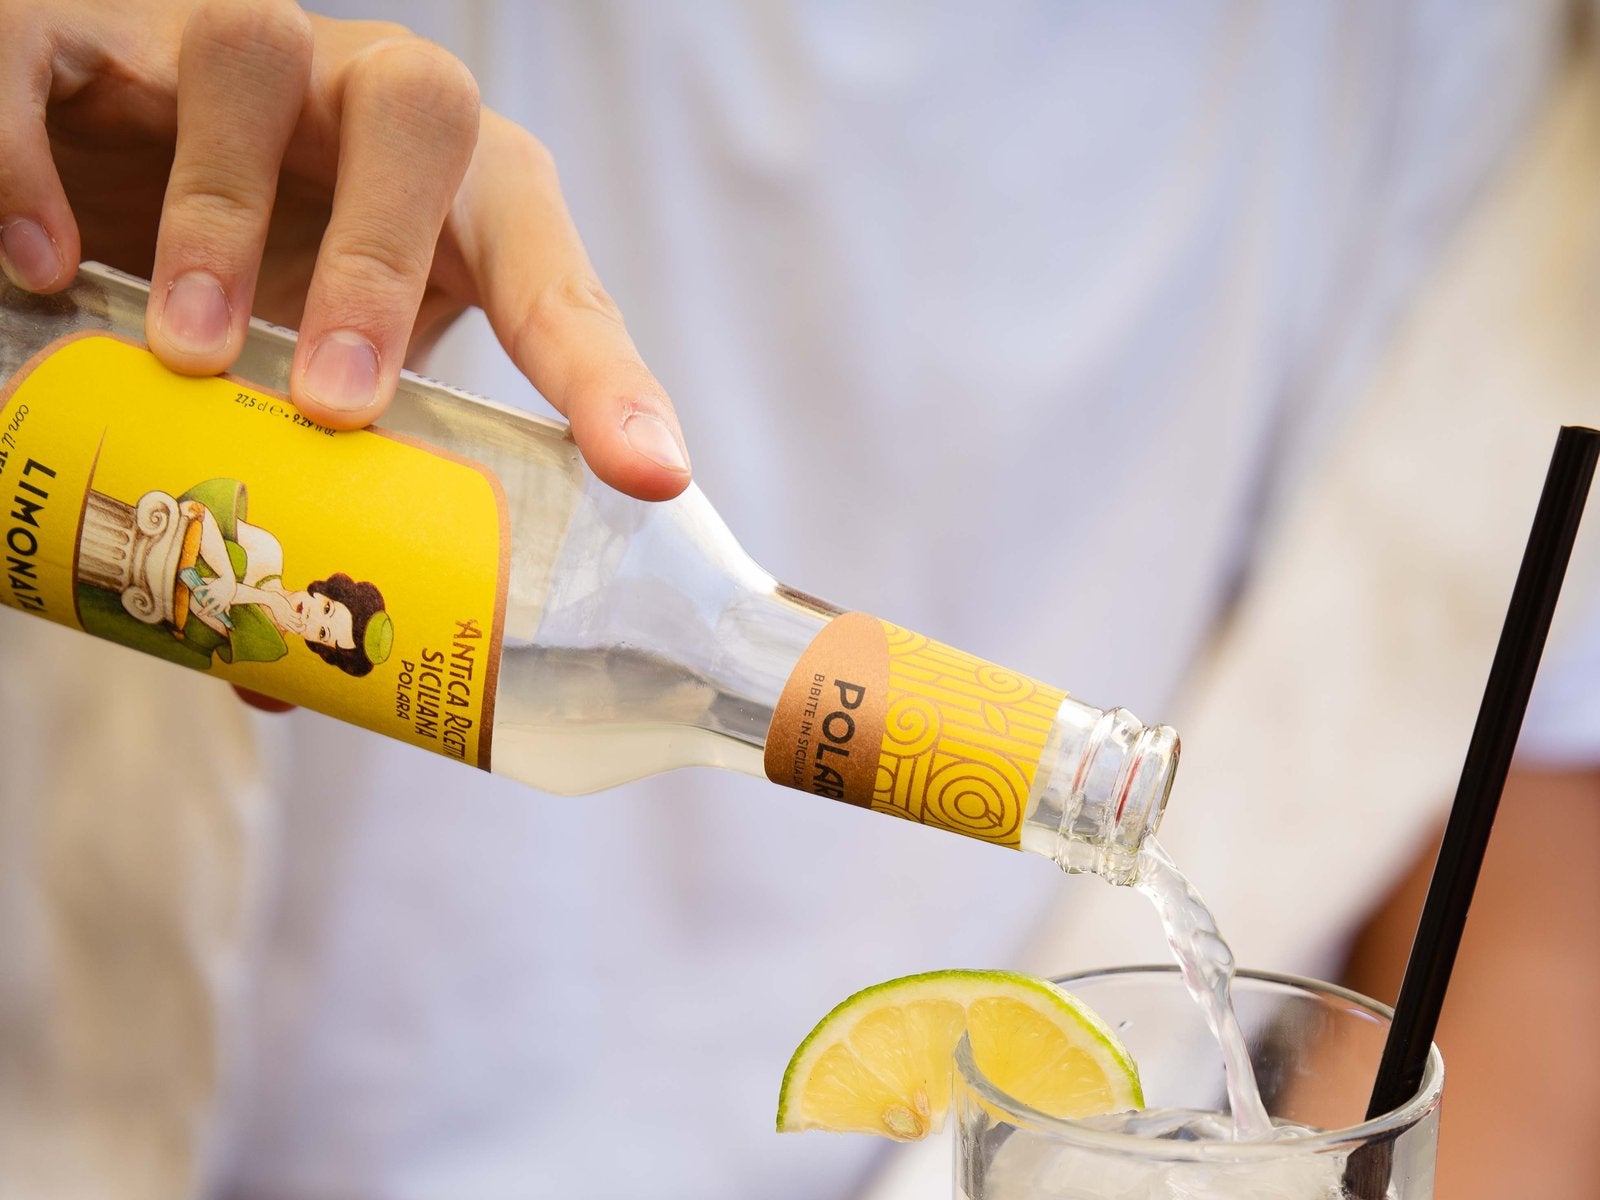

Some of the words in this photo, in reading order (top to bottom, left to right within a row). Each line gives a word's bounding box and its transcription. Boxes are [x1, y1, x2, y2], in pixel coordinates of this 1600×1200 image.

[8, 404, 29, 431] con
[235, 393, 257, 408] 27,5
[257, 401, 269, 412] cl
[1, 432, 16, 449] il
[446, 618, 483, 708] ANTICA
[396, 659, 415, 721] POLARA
[414, 647, 445, 740] SICILIANA
[803, 673, 825, 719] BIBITE
[801, 720, 813, 736] IN
